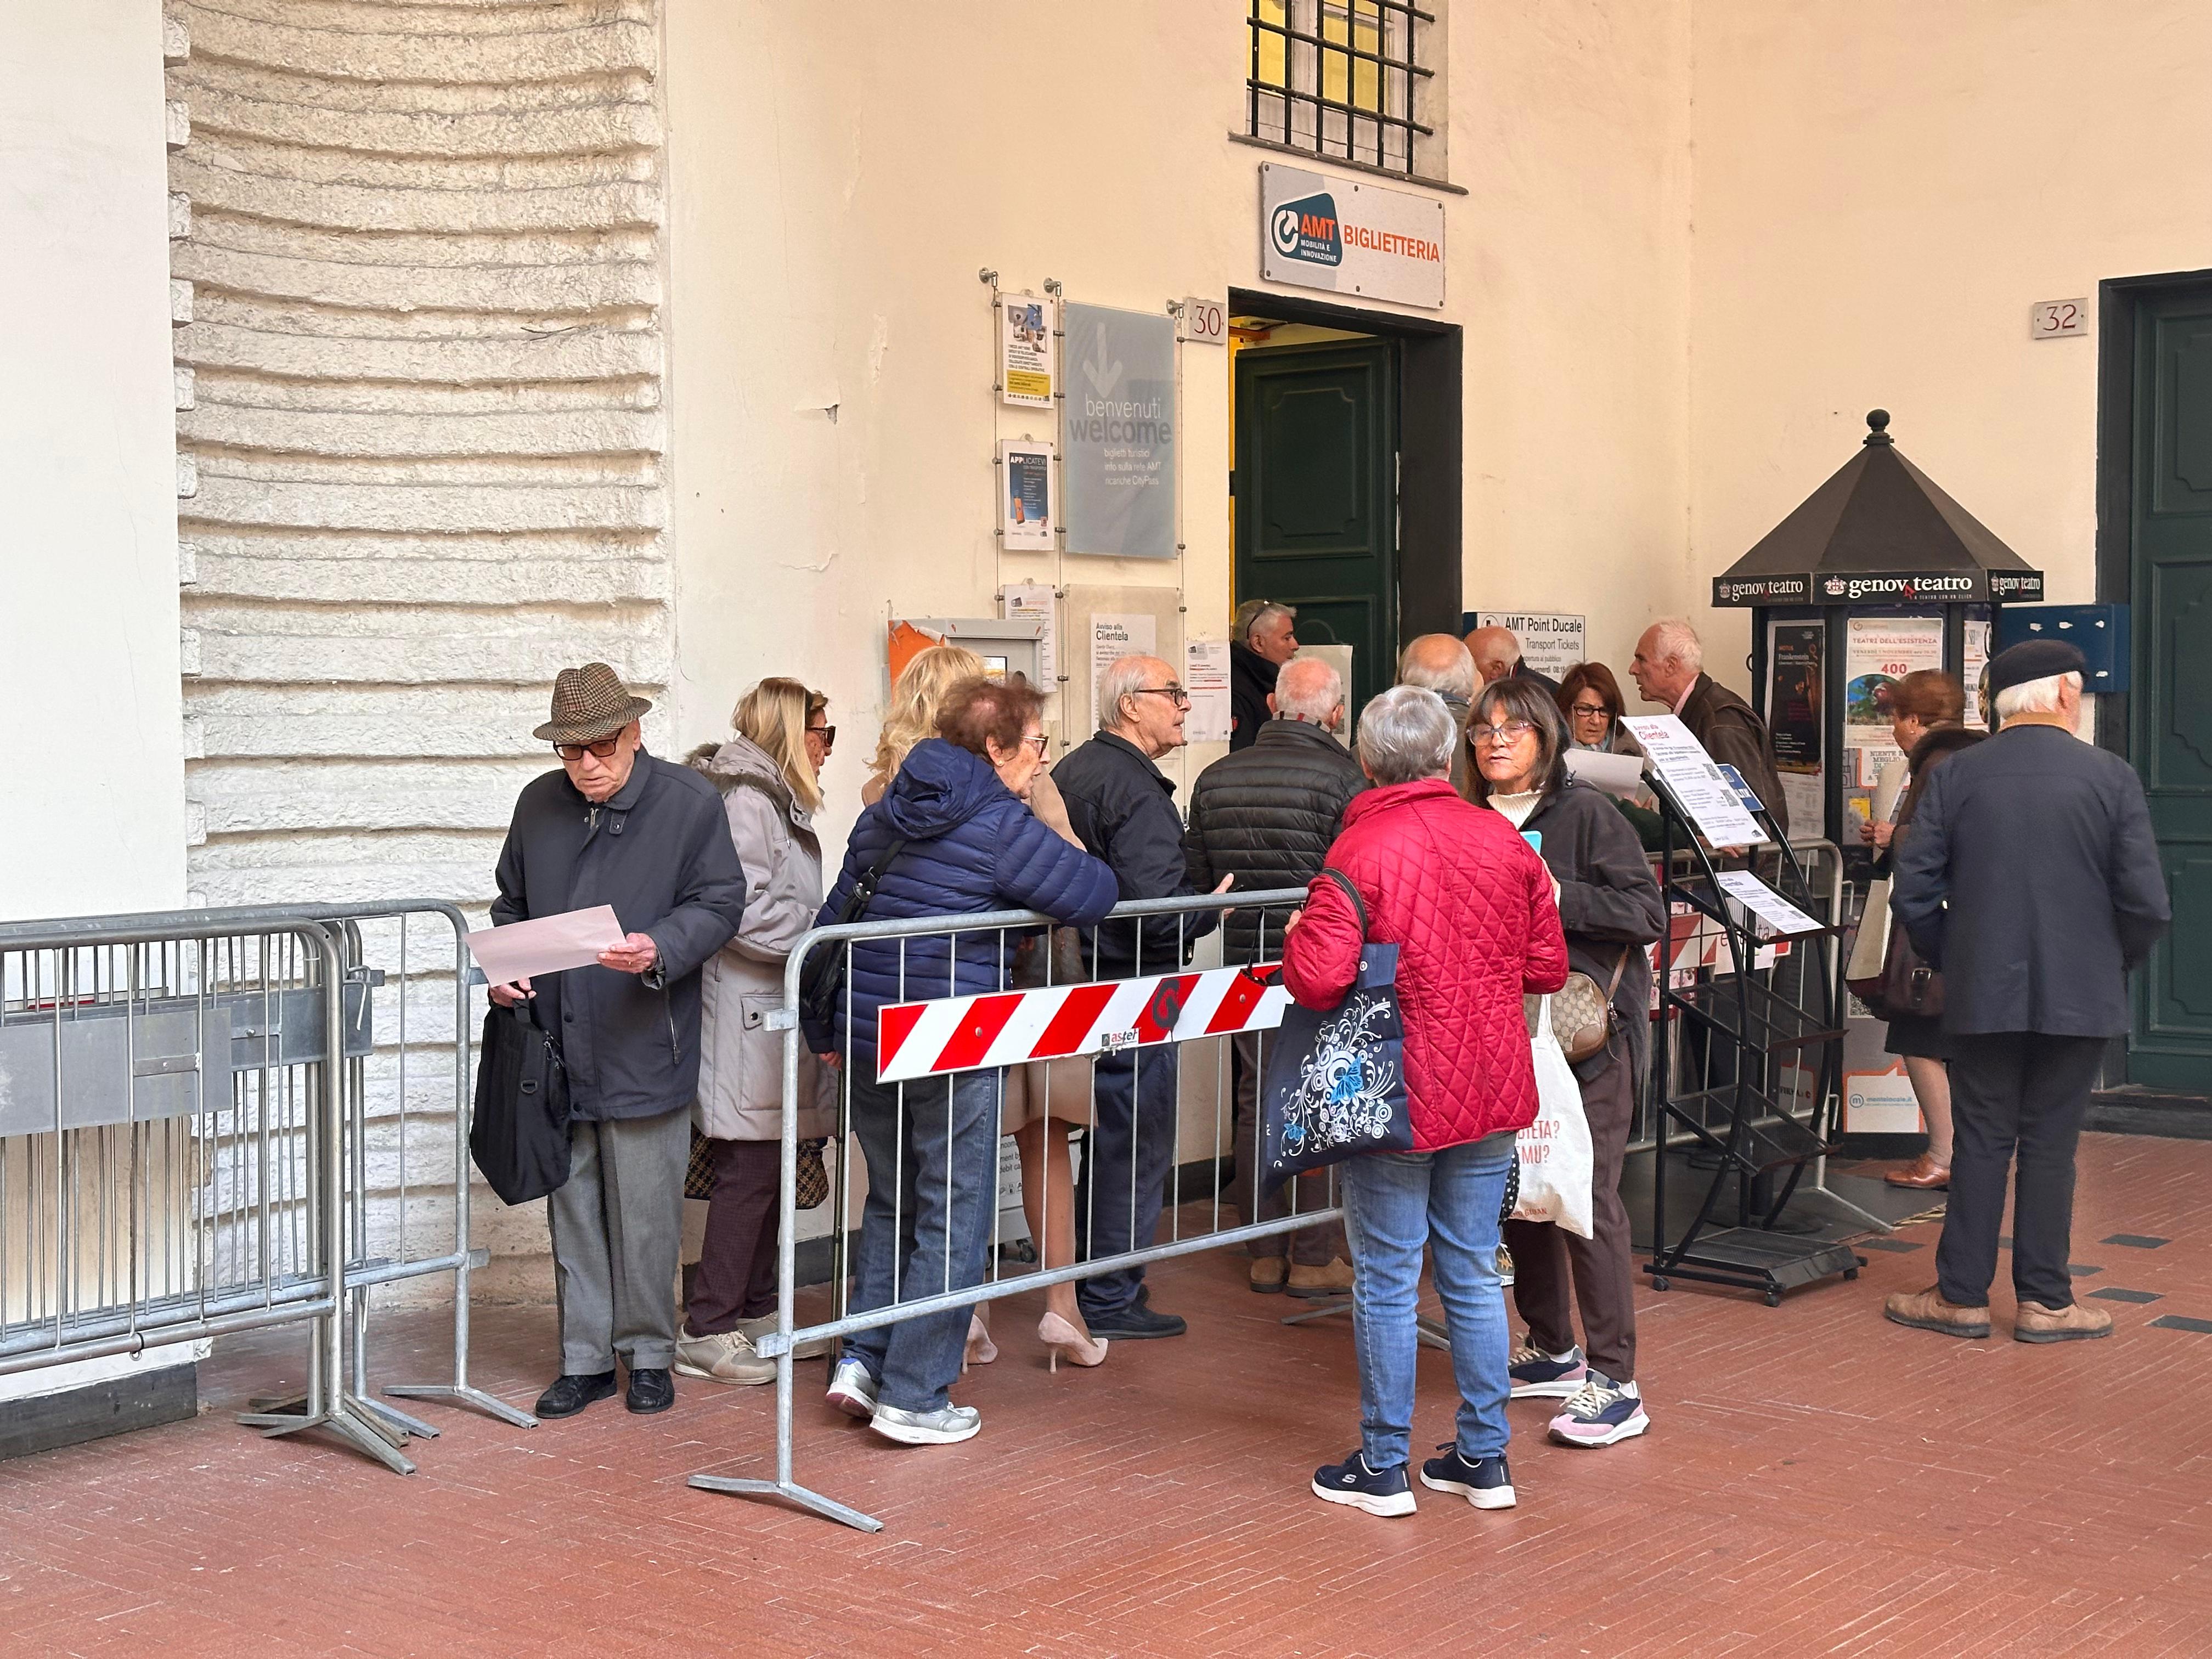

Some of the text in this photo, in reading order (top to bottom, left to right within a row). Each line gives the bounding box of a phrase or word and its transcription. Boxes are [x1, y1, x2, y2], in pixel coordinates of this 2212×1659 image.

[1301, 213, 1336, 241] AMT
[1301, 239, 1325, 251] MOBILITÀ
[1344, 224, 1440, 262] BIGLIETTERIA
[1301, 249, 1337, 263] INNOVAZIONE
[1194, 306, 1221, 336] 30
[2043, 304, 2076, 331] 32
[1086, 393, 1161, 419] benvenuti
[1069, 412, 1173, 444] welcome
[1010, 456, 1046, 466] APPLICATEVI
[1104, 448, 1150, 460] biglietti turistici
[1105, 461, 1161, 471] info sulla rete AMT
[1105, 475, 1159, 487] ricariche CityPass
[1769, 580, 1803, 595] teatro
[1914, 576, 1972, 591] teatro
[2021, 577, 2040, 590] teatro
[1505, 617, 1582, 633] AMT Point Ducale
[1096, 630, 1128, 641] Clientela
[1525, 637, 1579, 652] Transport Tickets
[1881, 664, 1908, 674] 400
[1639, 729, 1669, 740] Clientela
[1111, 1029, 1138, 1042] aster
[1516, 1145, 1550, 1164] MU?
